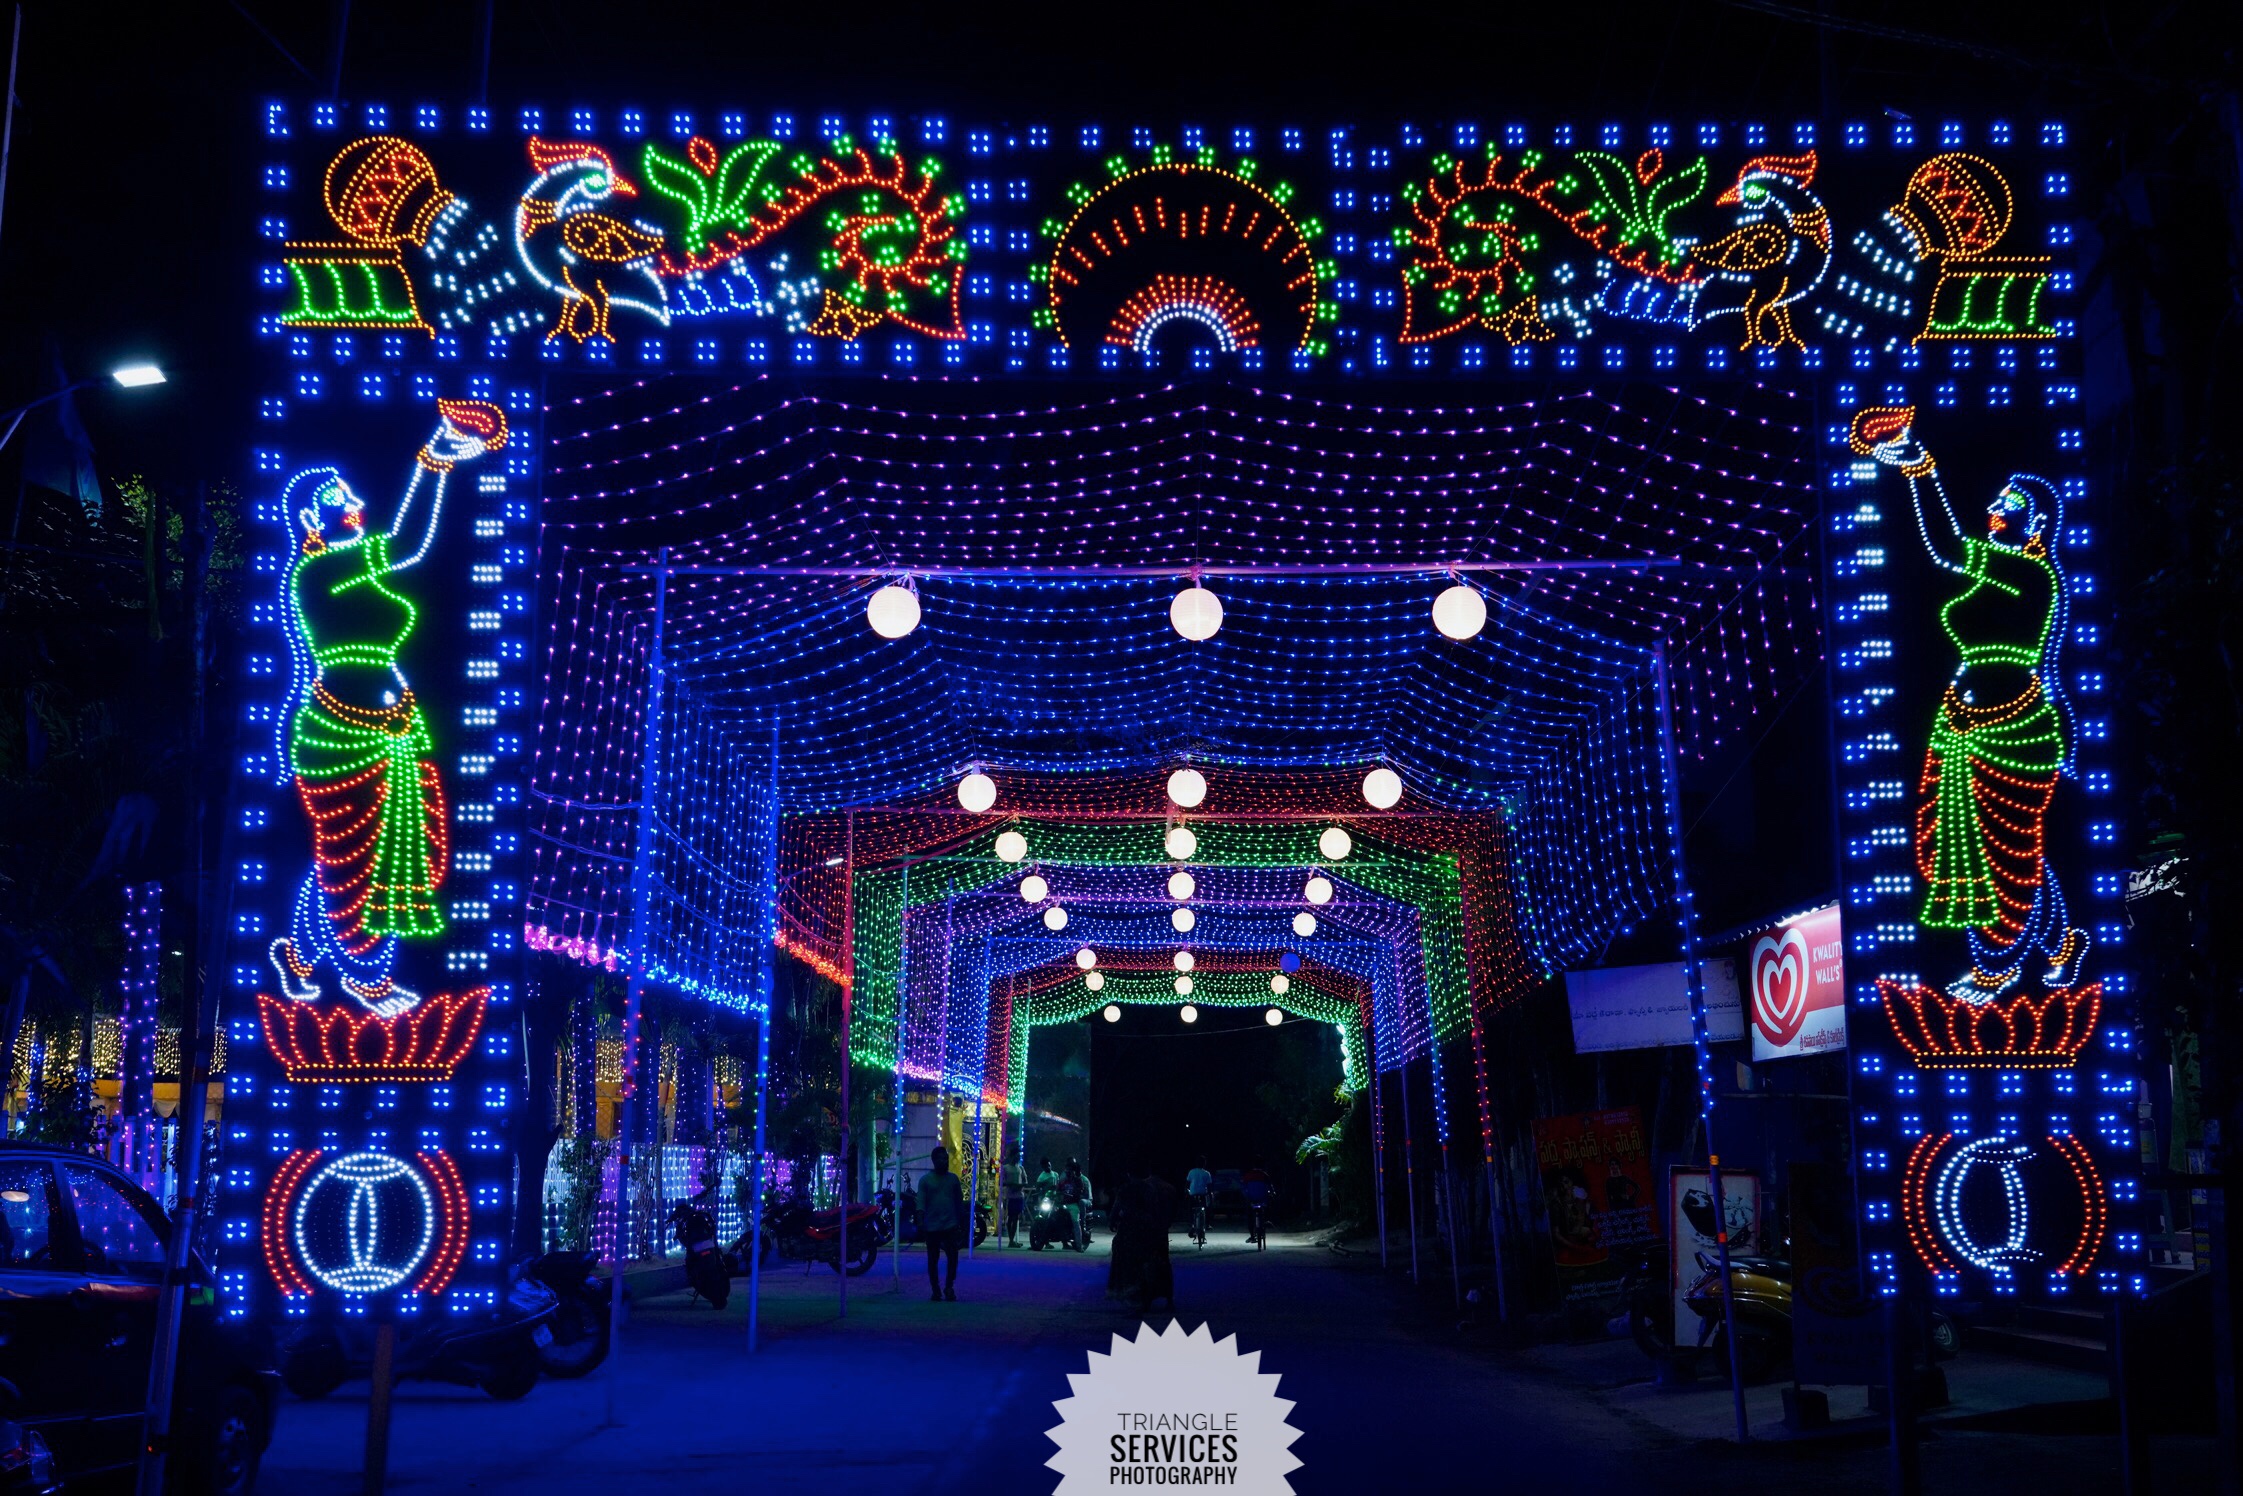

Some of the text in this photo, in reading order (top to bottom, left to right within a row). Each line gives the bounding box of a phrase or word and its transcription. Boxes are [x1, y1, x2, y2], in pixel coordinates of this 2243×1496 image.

[1812, 940, 1842, 963] KWALITY
[1815, 965, 1840, 985] WALL'S
[1602, 1137, 1612, 1154] &
